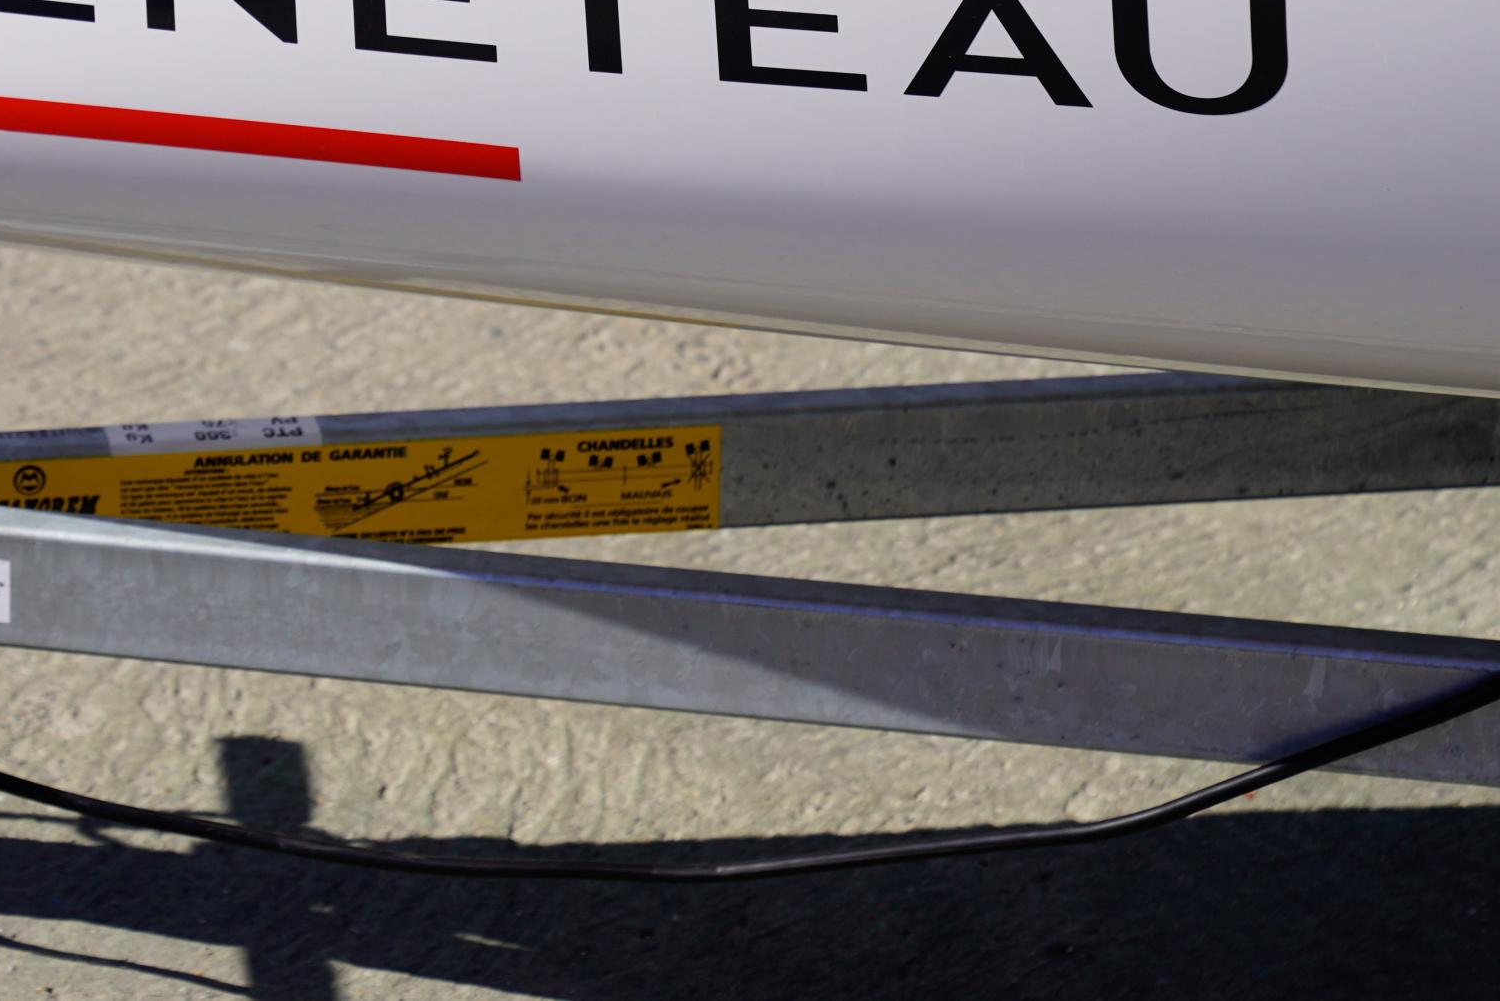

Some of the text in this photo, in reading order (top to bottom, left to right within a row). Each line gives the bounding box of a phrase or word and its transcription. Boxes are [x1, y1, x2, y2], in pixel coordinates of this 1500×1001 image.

[577, 436, 674, 453] CHANDELLES
[194, 446, 408, 467] ANNULATION DE GARANTIE
